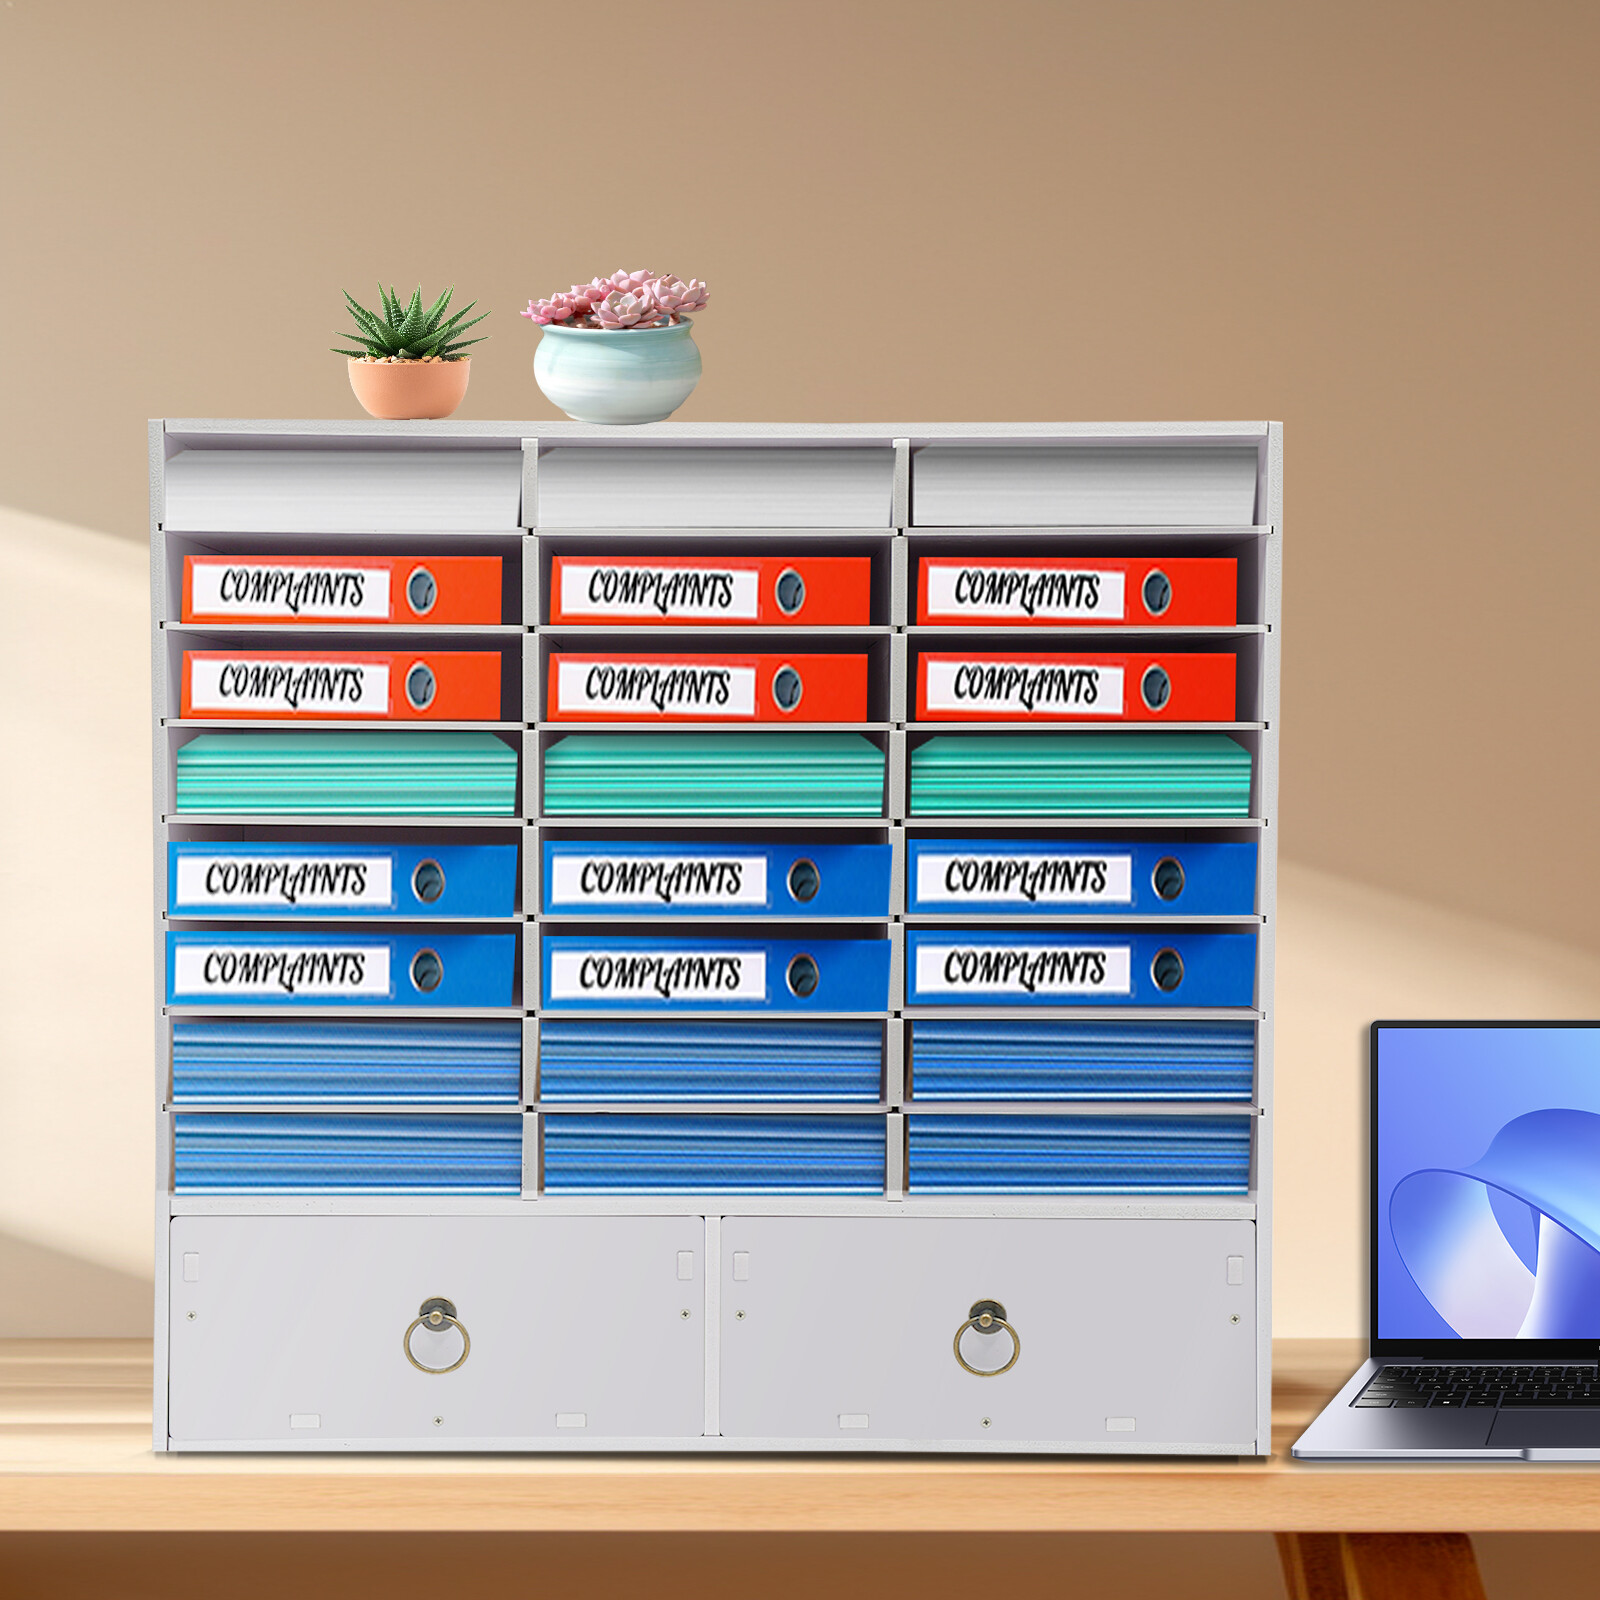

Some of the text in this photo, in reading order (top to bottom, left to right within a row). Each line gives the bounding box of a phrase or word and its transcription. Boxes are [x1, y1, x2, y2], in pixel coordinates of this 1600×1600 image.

[221, 571, 364, 613] COMPLAINTS
[589, 570, 733, 614] COMPLAINTS
[956, 571, 1099, 615] COMPLAINTS
[220, 666, 363, 709] COMPLAINTS
[586, 666, 730, 711] COMPLAINTS
[955, 666, 1098, 711] COMPLAINTS
[207, 864, 366, 904] COMPLAINTS
[581, 863, 742, 903] COMPLAINTS
[946, 861, 1107, 902] COMPLAINTS
[205, 953, 364, 993] COMPLAINTS
[580, 958, 741, 1000] COMPLAINTS
[945, 952, 1106, 994] COMPLAINTS
